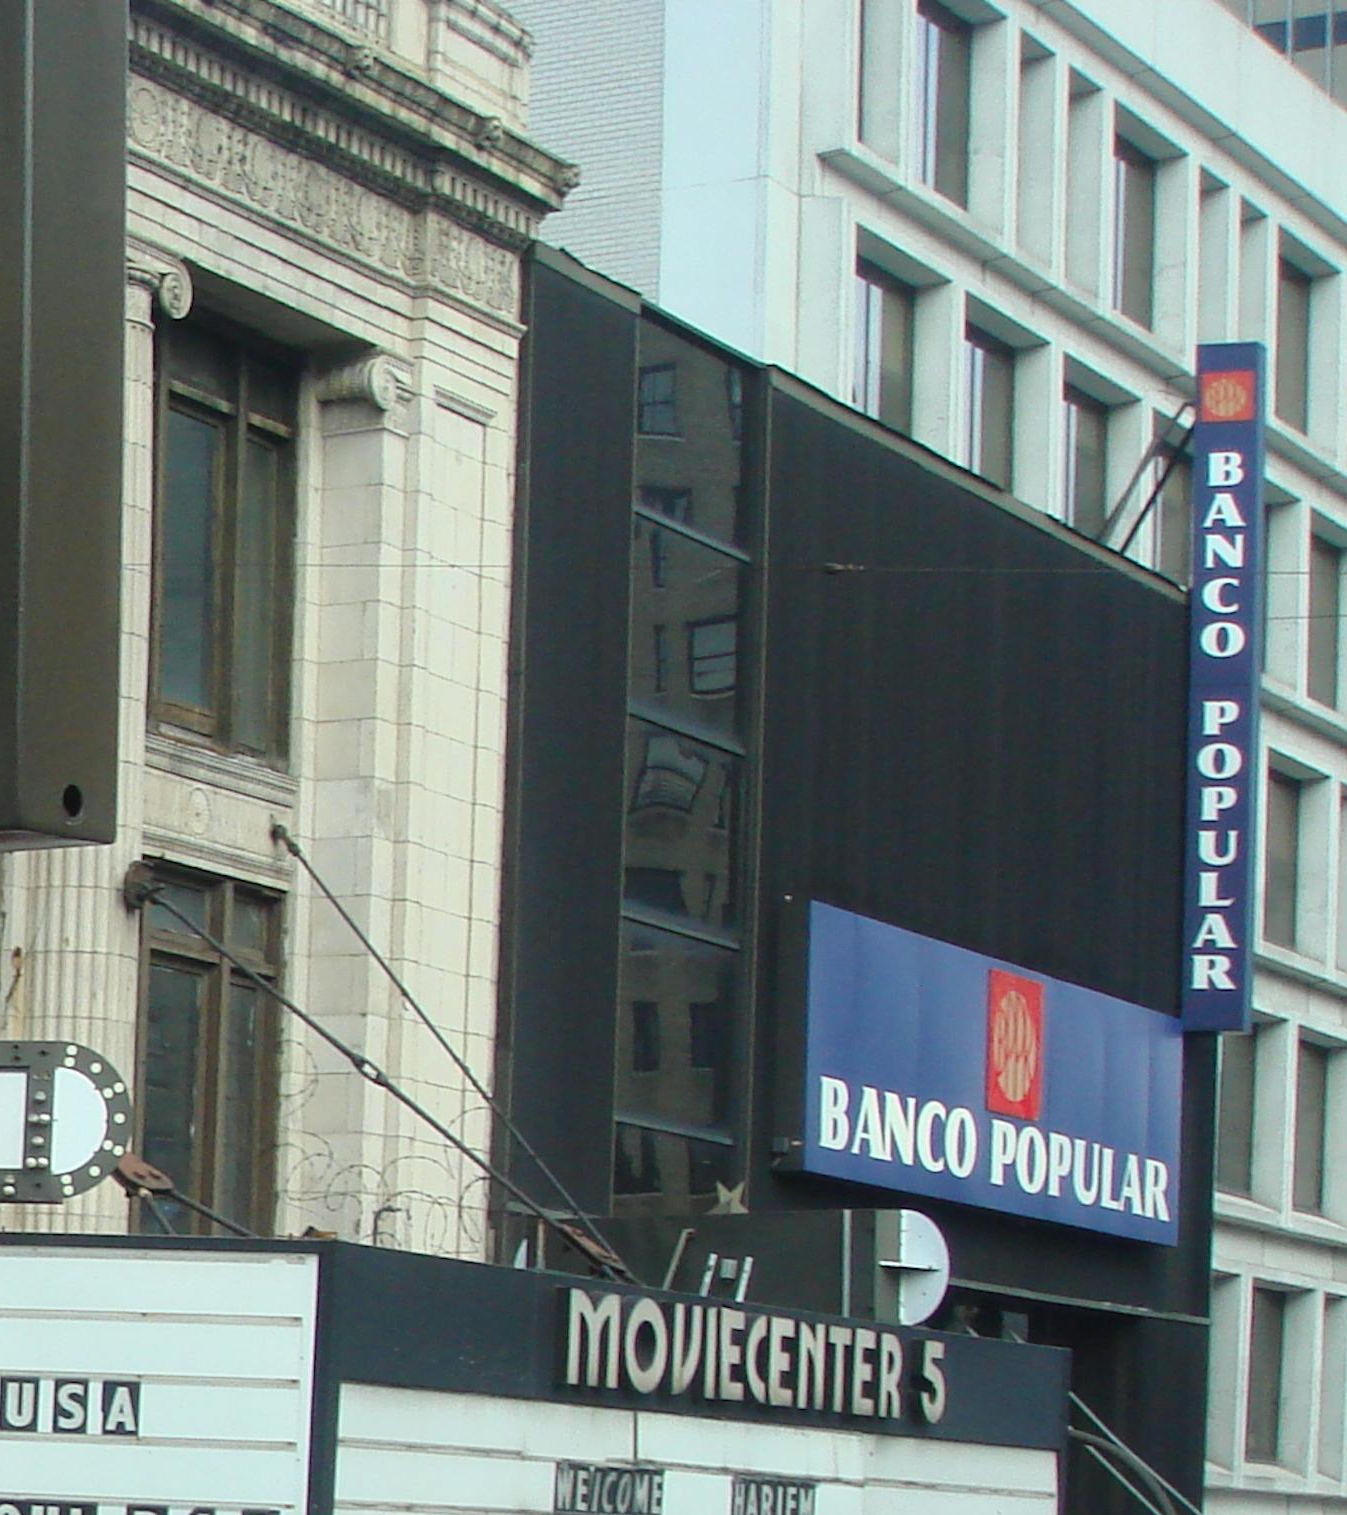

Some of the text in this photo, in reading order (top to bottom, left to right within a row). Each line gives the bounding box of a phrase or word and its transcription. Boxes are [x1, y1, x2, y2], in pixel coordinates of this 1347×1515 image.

[1190, 451, 1247, 992] BANCO POPULAR
[819, 1075, 1170, 1223] BANCO POPULAR
[566, 1289, 947, 1425] MOVIECENTER 5
